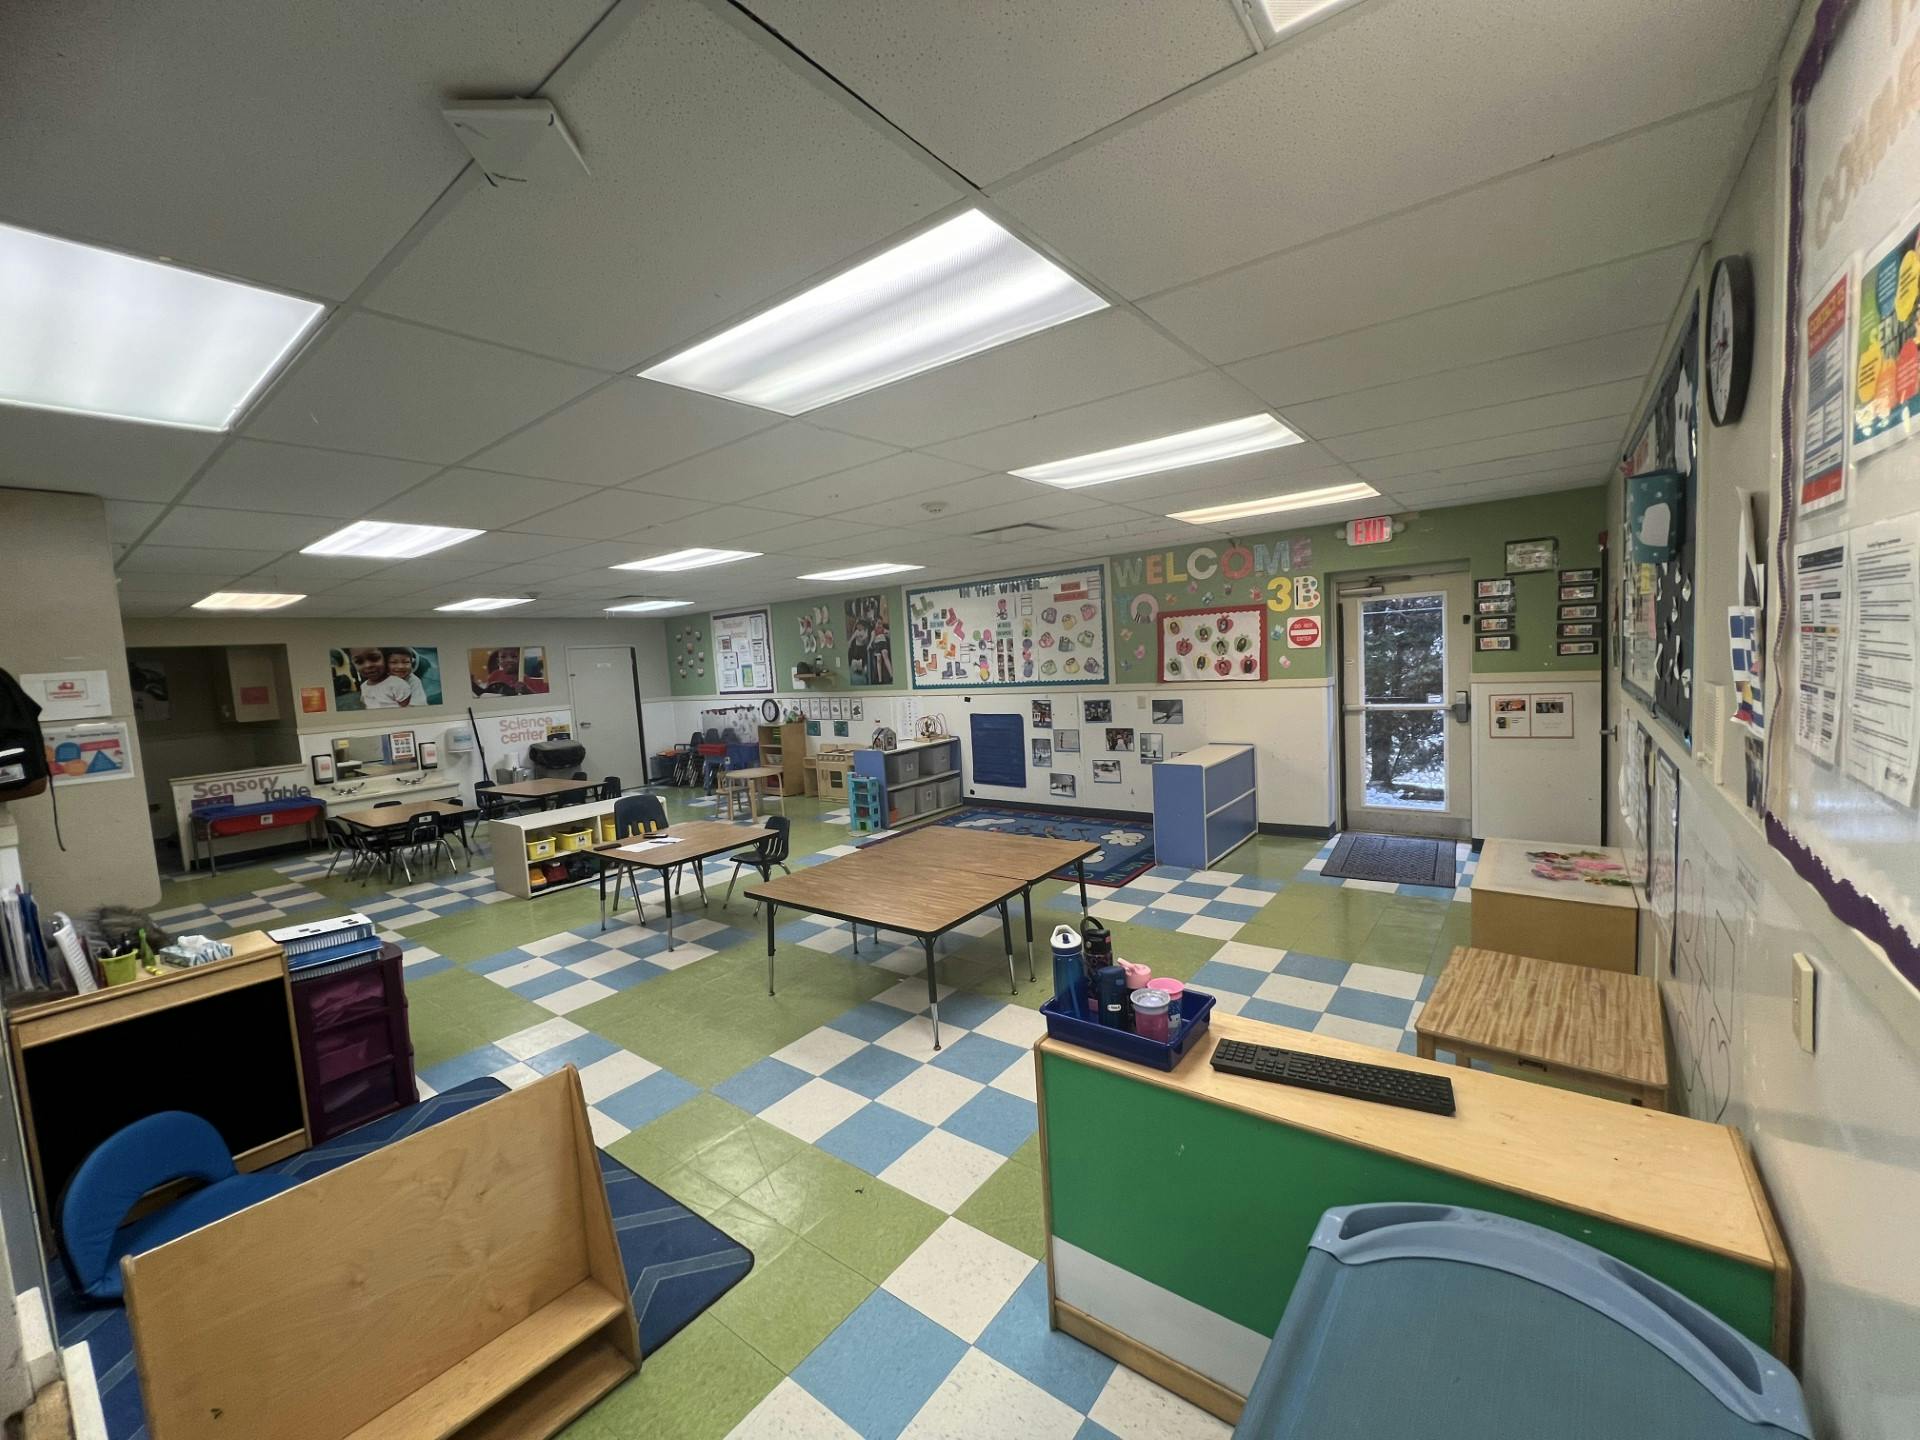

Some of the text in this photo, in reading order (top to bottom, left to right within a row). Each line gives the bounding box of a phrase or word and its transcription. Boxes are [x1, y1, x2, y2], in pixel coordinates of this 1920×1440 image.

[1354, 517, 1385, 544] EXIT
[1113, 538, 1312, 588] WELCOME
[959, 586, 971, 599] IN
[975, 584, 996, 597] THE
[1267, 575, 1321, 612] 3B
[499, 716, 553, 732] Science
[500, 729, 545, 745] center
[193, 775, 280, 798] Sensory
[263, 784, 311, 802] table
